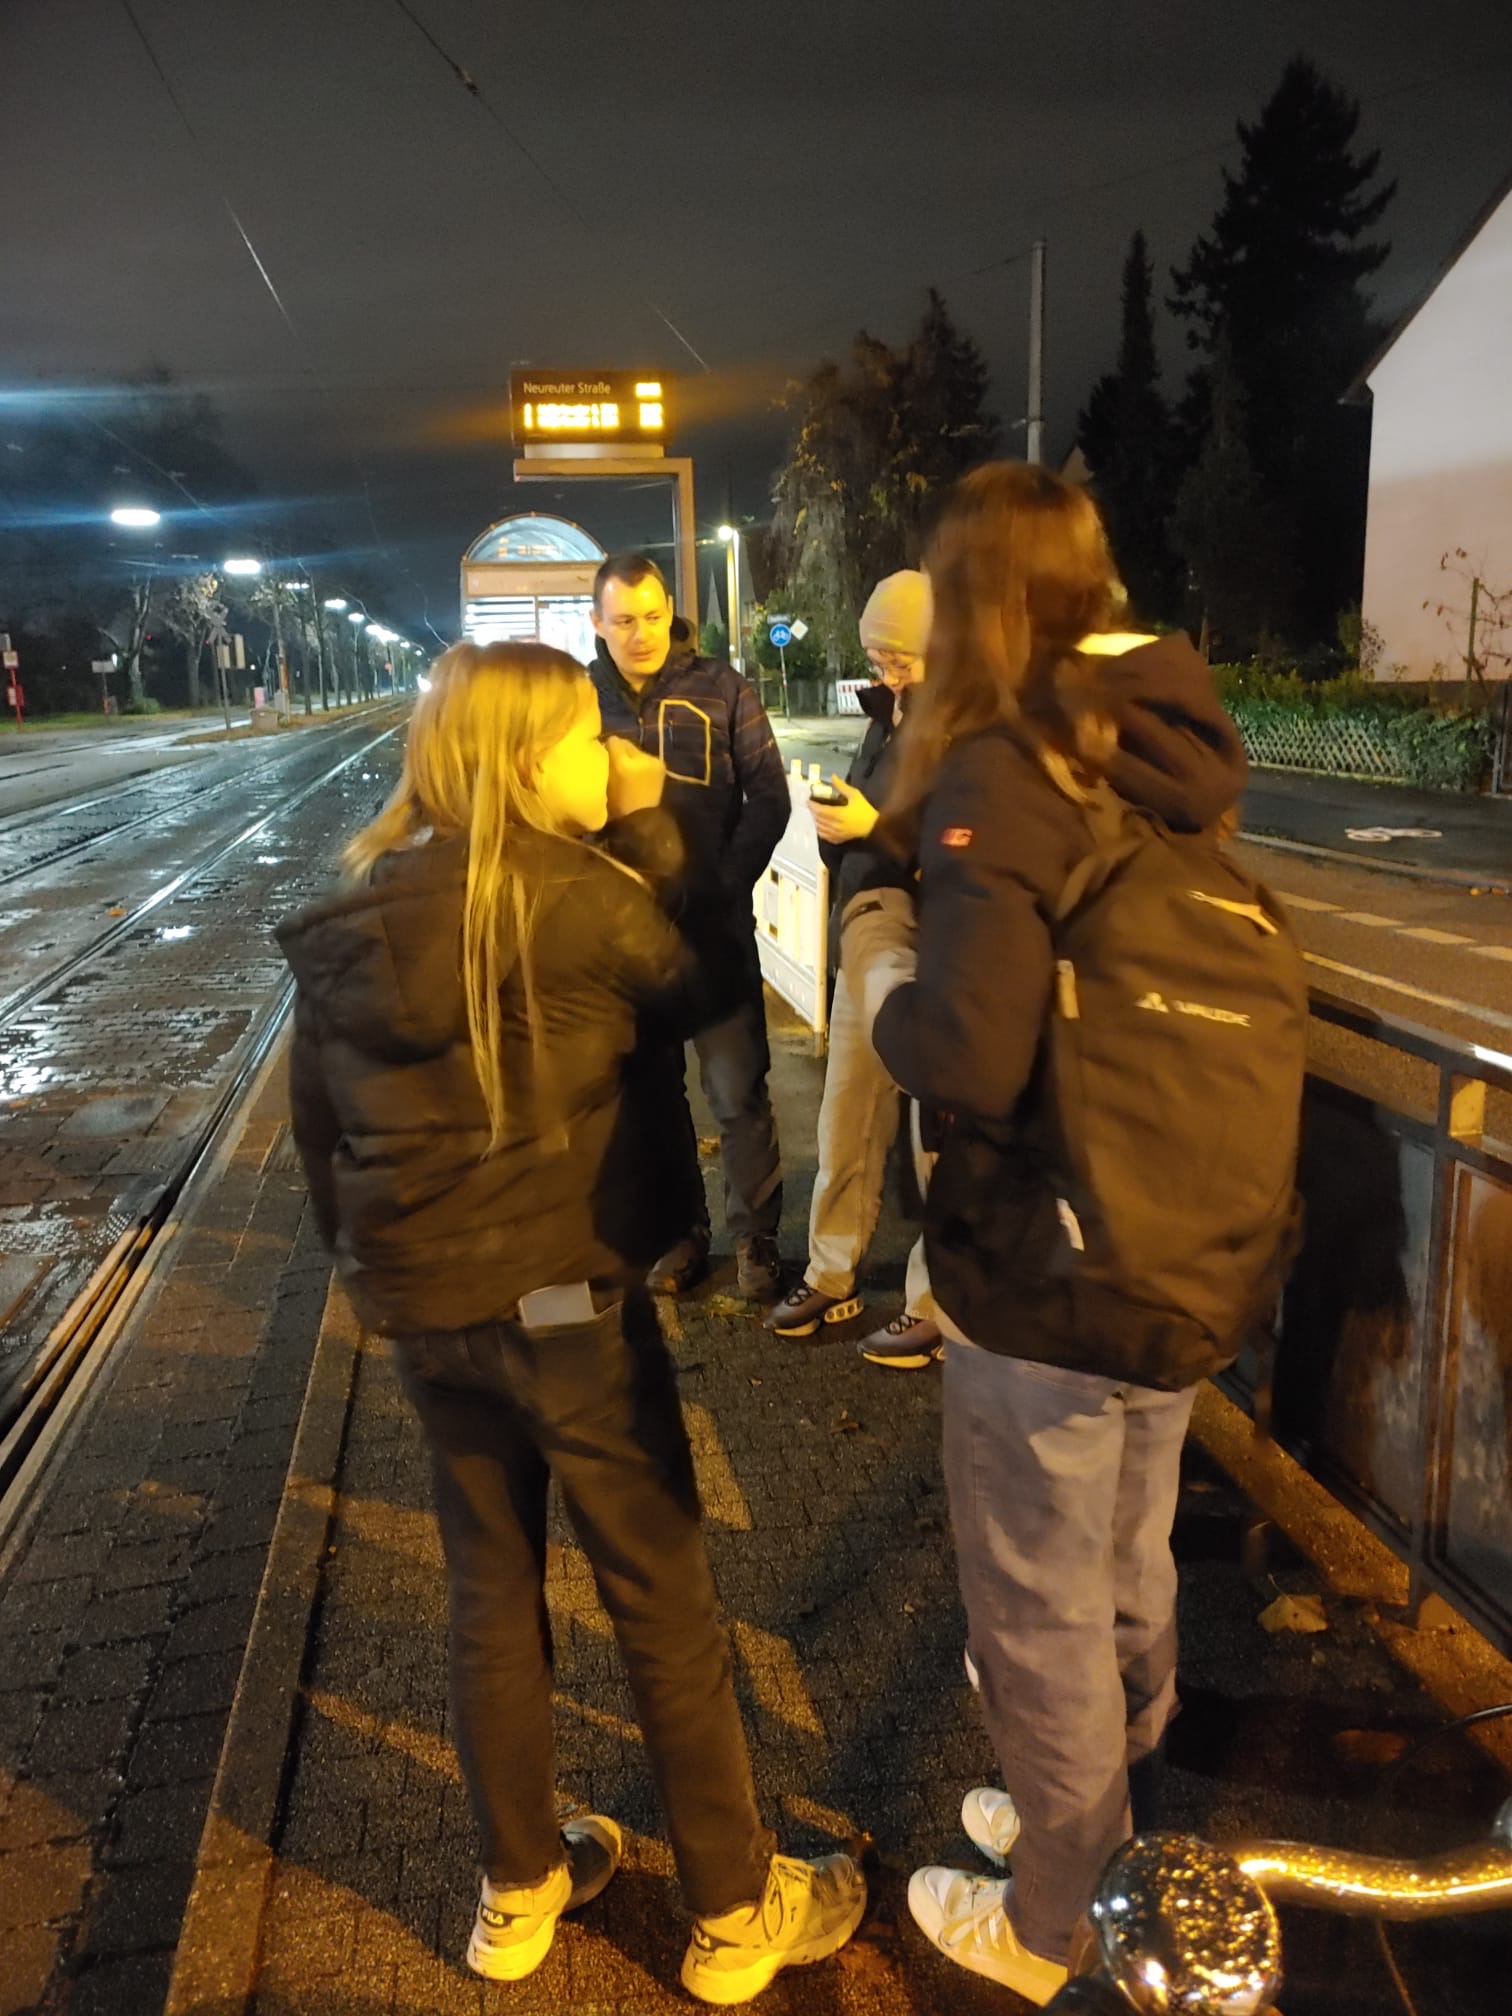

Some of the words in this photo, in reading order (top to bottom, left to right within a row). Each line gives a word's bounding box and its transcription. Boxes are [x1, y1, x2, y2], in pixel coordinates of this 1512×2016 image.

[523, 381, 575, 394] Neureuter
[578, 381, 611, 394] Straße
[482, 1907, 504, 1926] FILA
